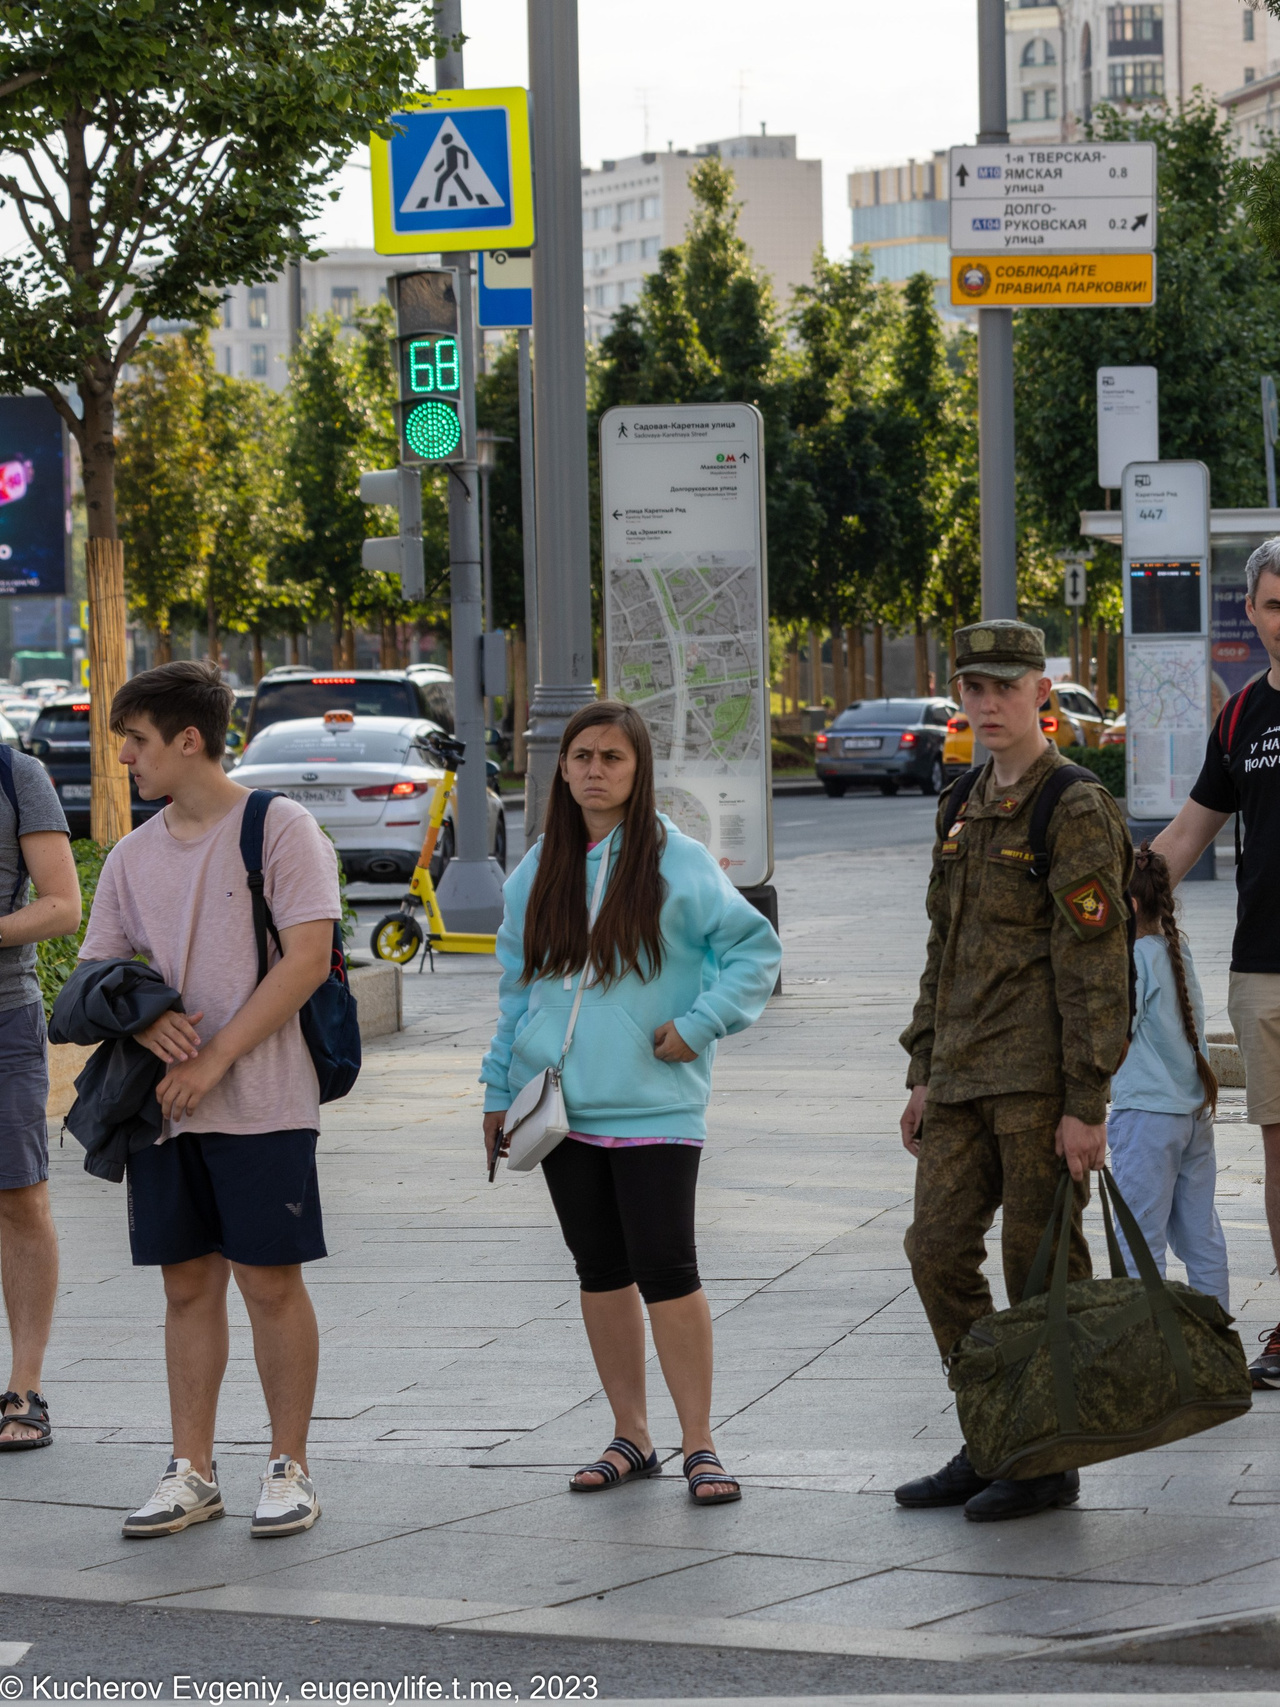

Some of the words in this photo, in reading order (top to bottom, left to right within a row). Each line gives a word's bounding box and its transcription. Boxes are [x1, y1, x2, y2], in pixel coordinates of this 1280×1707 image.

[1004, 152, 1025, 164] 1-я
[1028, 151, 1107, 164] ТВЕРСКАЯ-
[1004, 168, 1063, 179] ЯМСКАЯ
[1109, 167, 1128, 178] 0.8
[1004, 184, 1044, 194] улица
[1004, 203, 1057, 216] ДОЛГО-
[1004, 219, 1088, 231] РУКОВСКАЯ
[1108, 218, 1128, 230] 0.2
[1004, 235, 1045, 246] улица
[995, 263, 1097, 279] СОБЛЮДАЙТЕ
[995, 282, 1062, 295] ПРАВИЛА
[1066, 281, 1147, 294] ПАРКОВКИ!
[410, 339, 459, 392] 68
[634, 422, 710, 431] Садовая-Каретная
[711, 421, 736, 431] улица
[1138, 508, 1163, 521] 447
